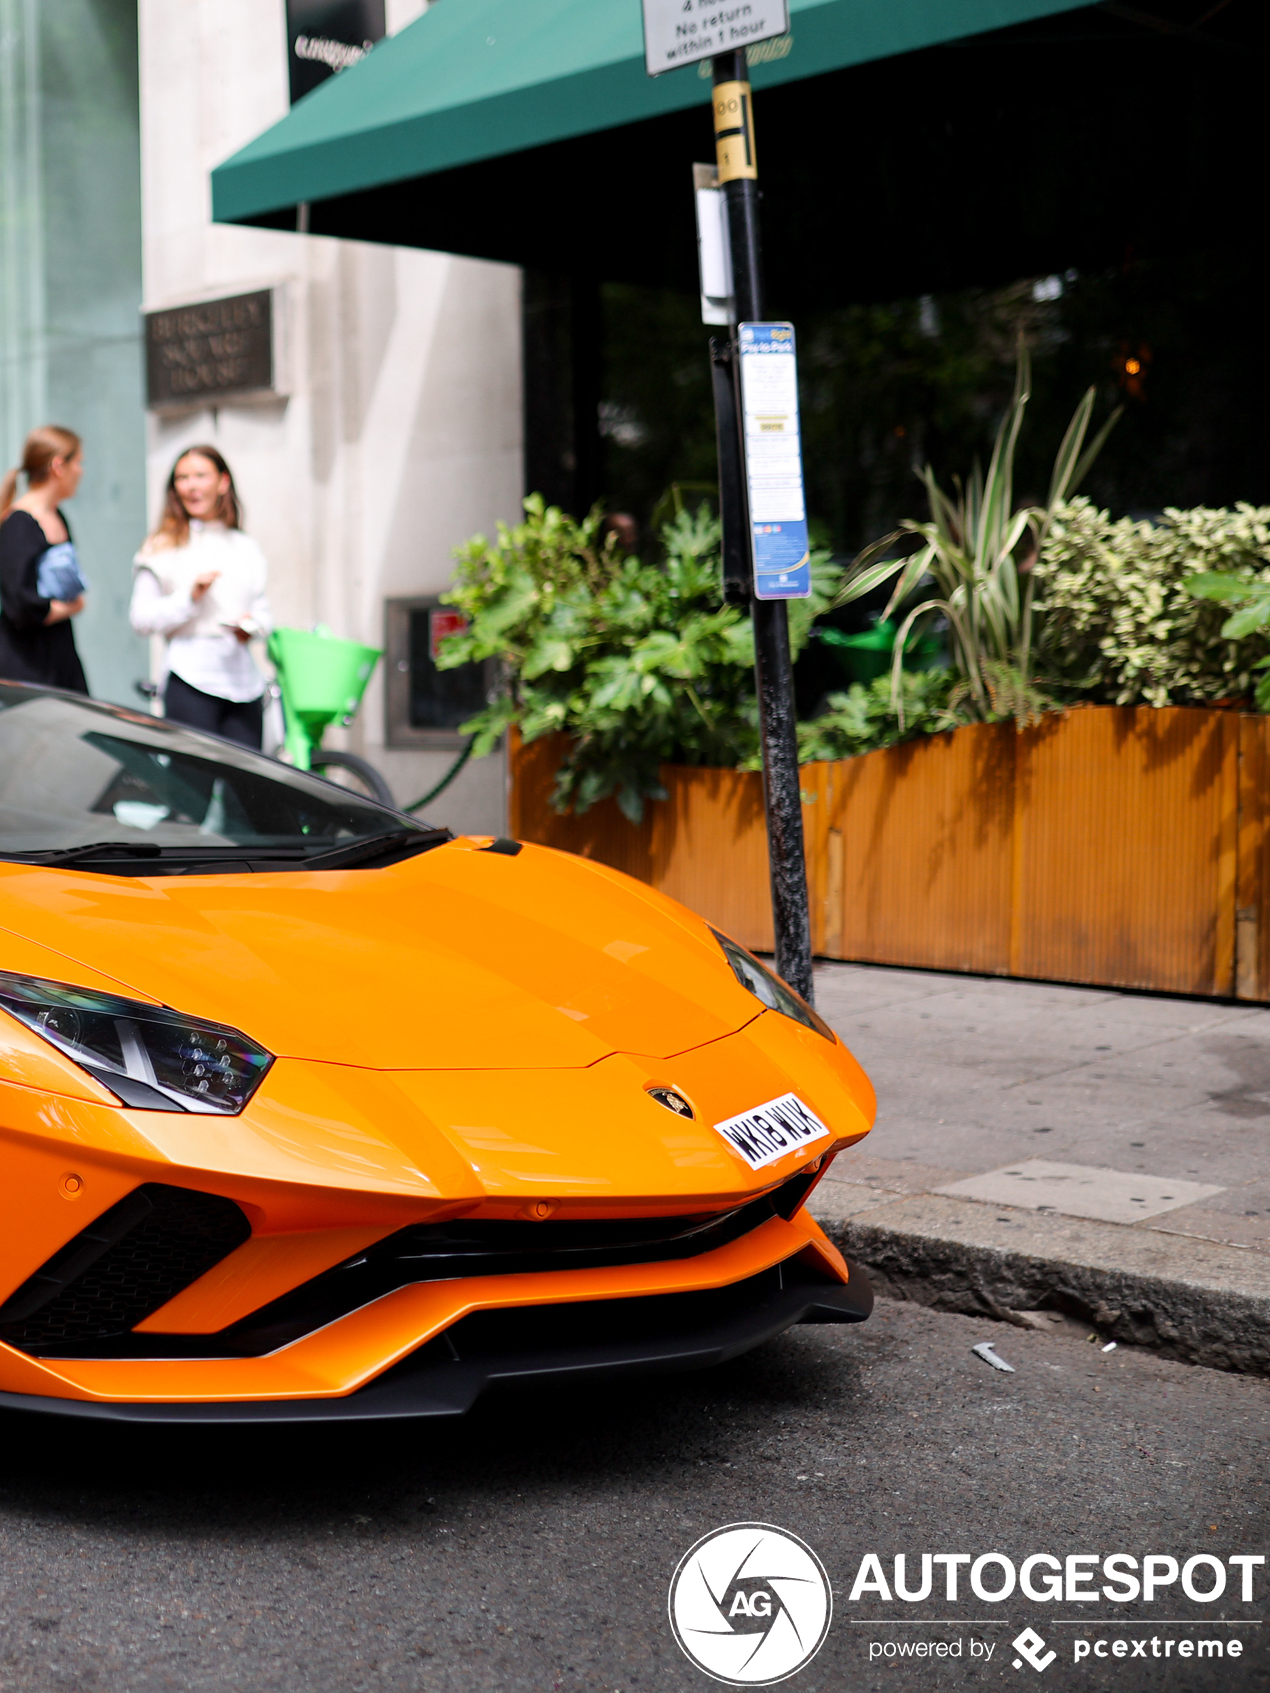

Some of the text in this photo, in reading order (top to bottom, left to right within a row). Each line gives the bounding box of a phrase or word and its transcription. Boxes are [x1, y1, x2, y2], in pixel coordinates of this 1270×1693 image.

[666, 19, 766, 61] within 1 hour
[676, 4, 752, 38] No return
[722, 1098, 822, 1163] WK18 WUK
